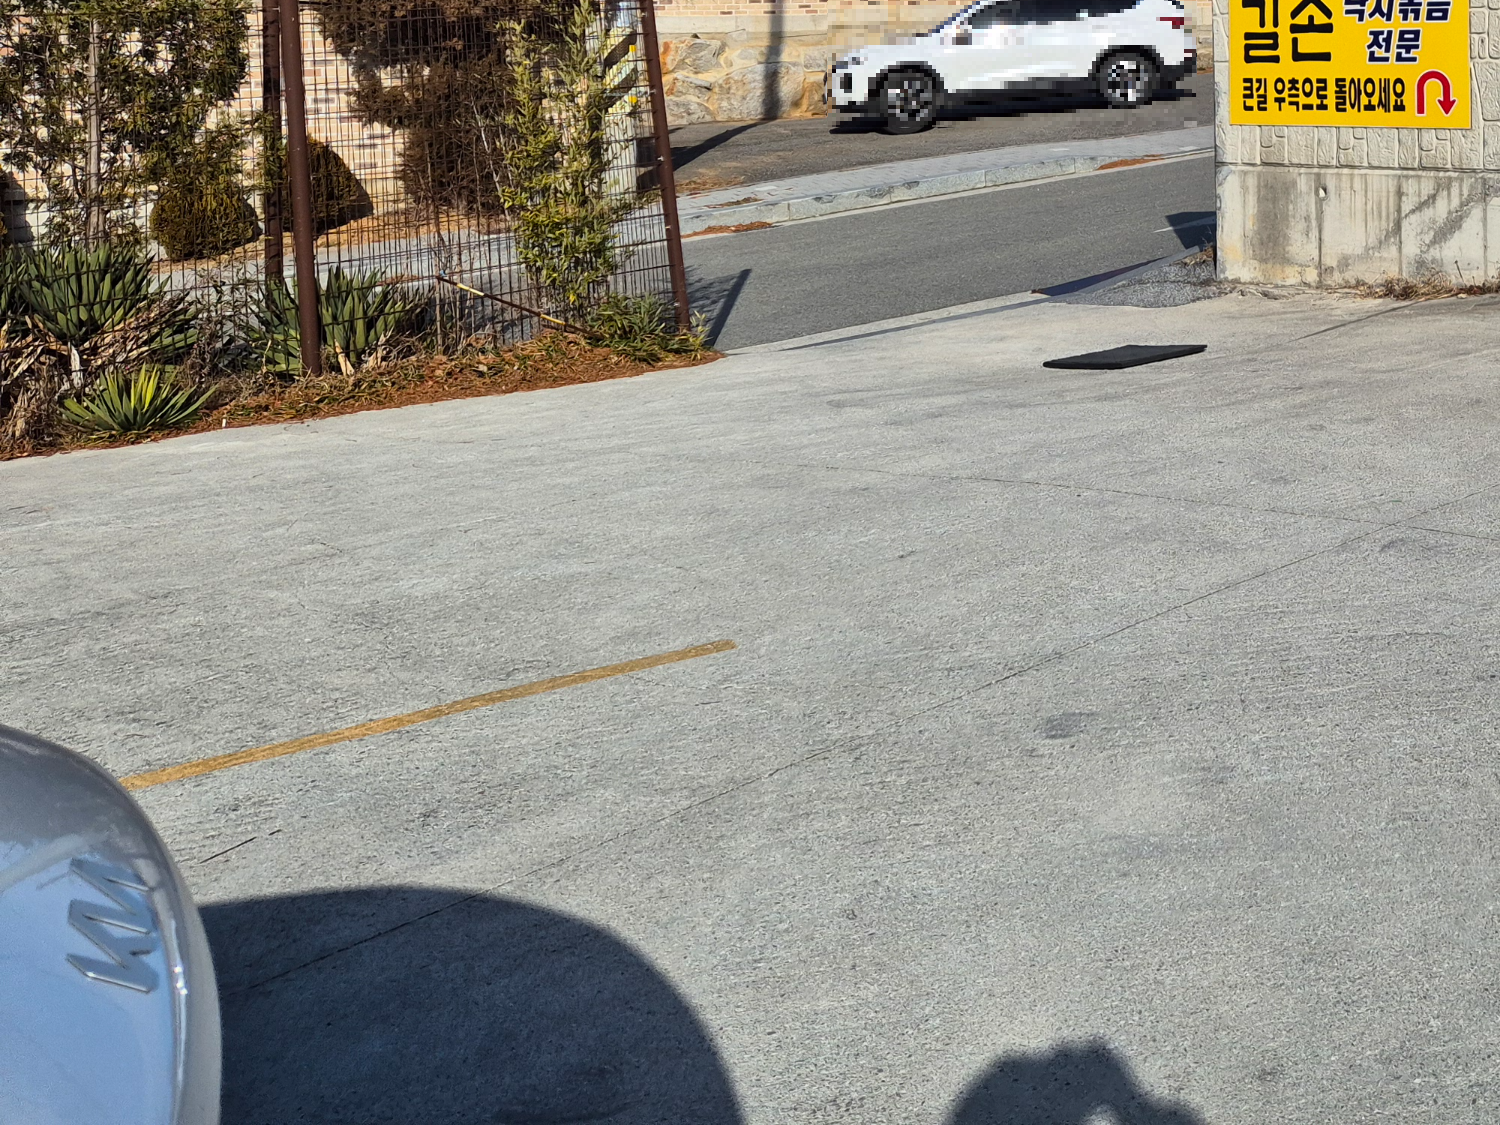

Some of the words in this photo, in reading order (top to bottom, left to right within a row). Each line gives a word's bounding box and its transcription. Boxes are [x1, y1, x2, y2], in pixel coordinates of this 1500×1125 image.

[1366, 28, 1422, 64] 전문
[1242, 77, 1268, 112] 큰길
[1273, 77, 1329, 112] 우측으로
[1334, 77, 1406, 113] 돌아오세요
